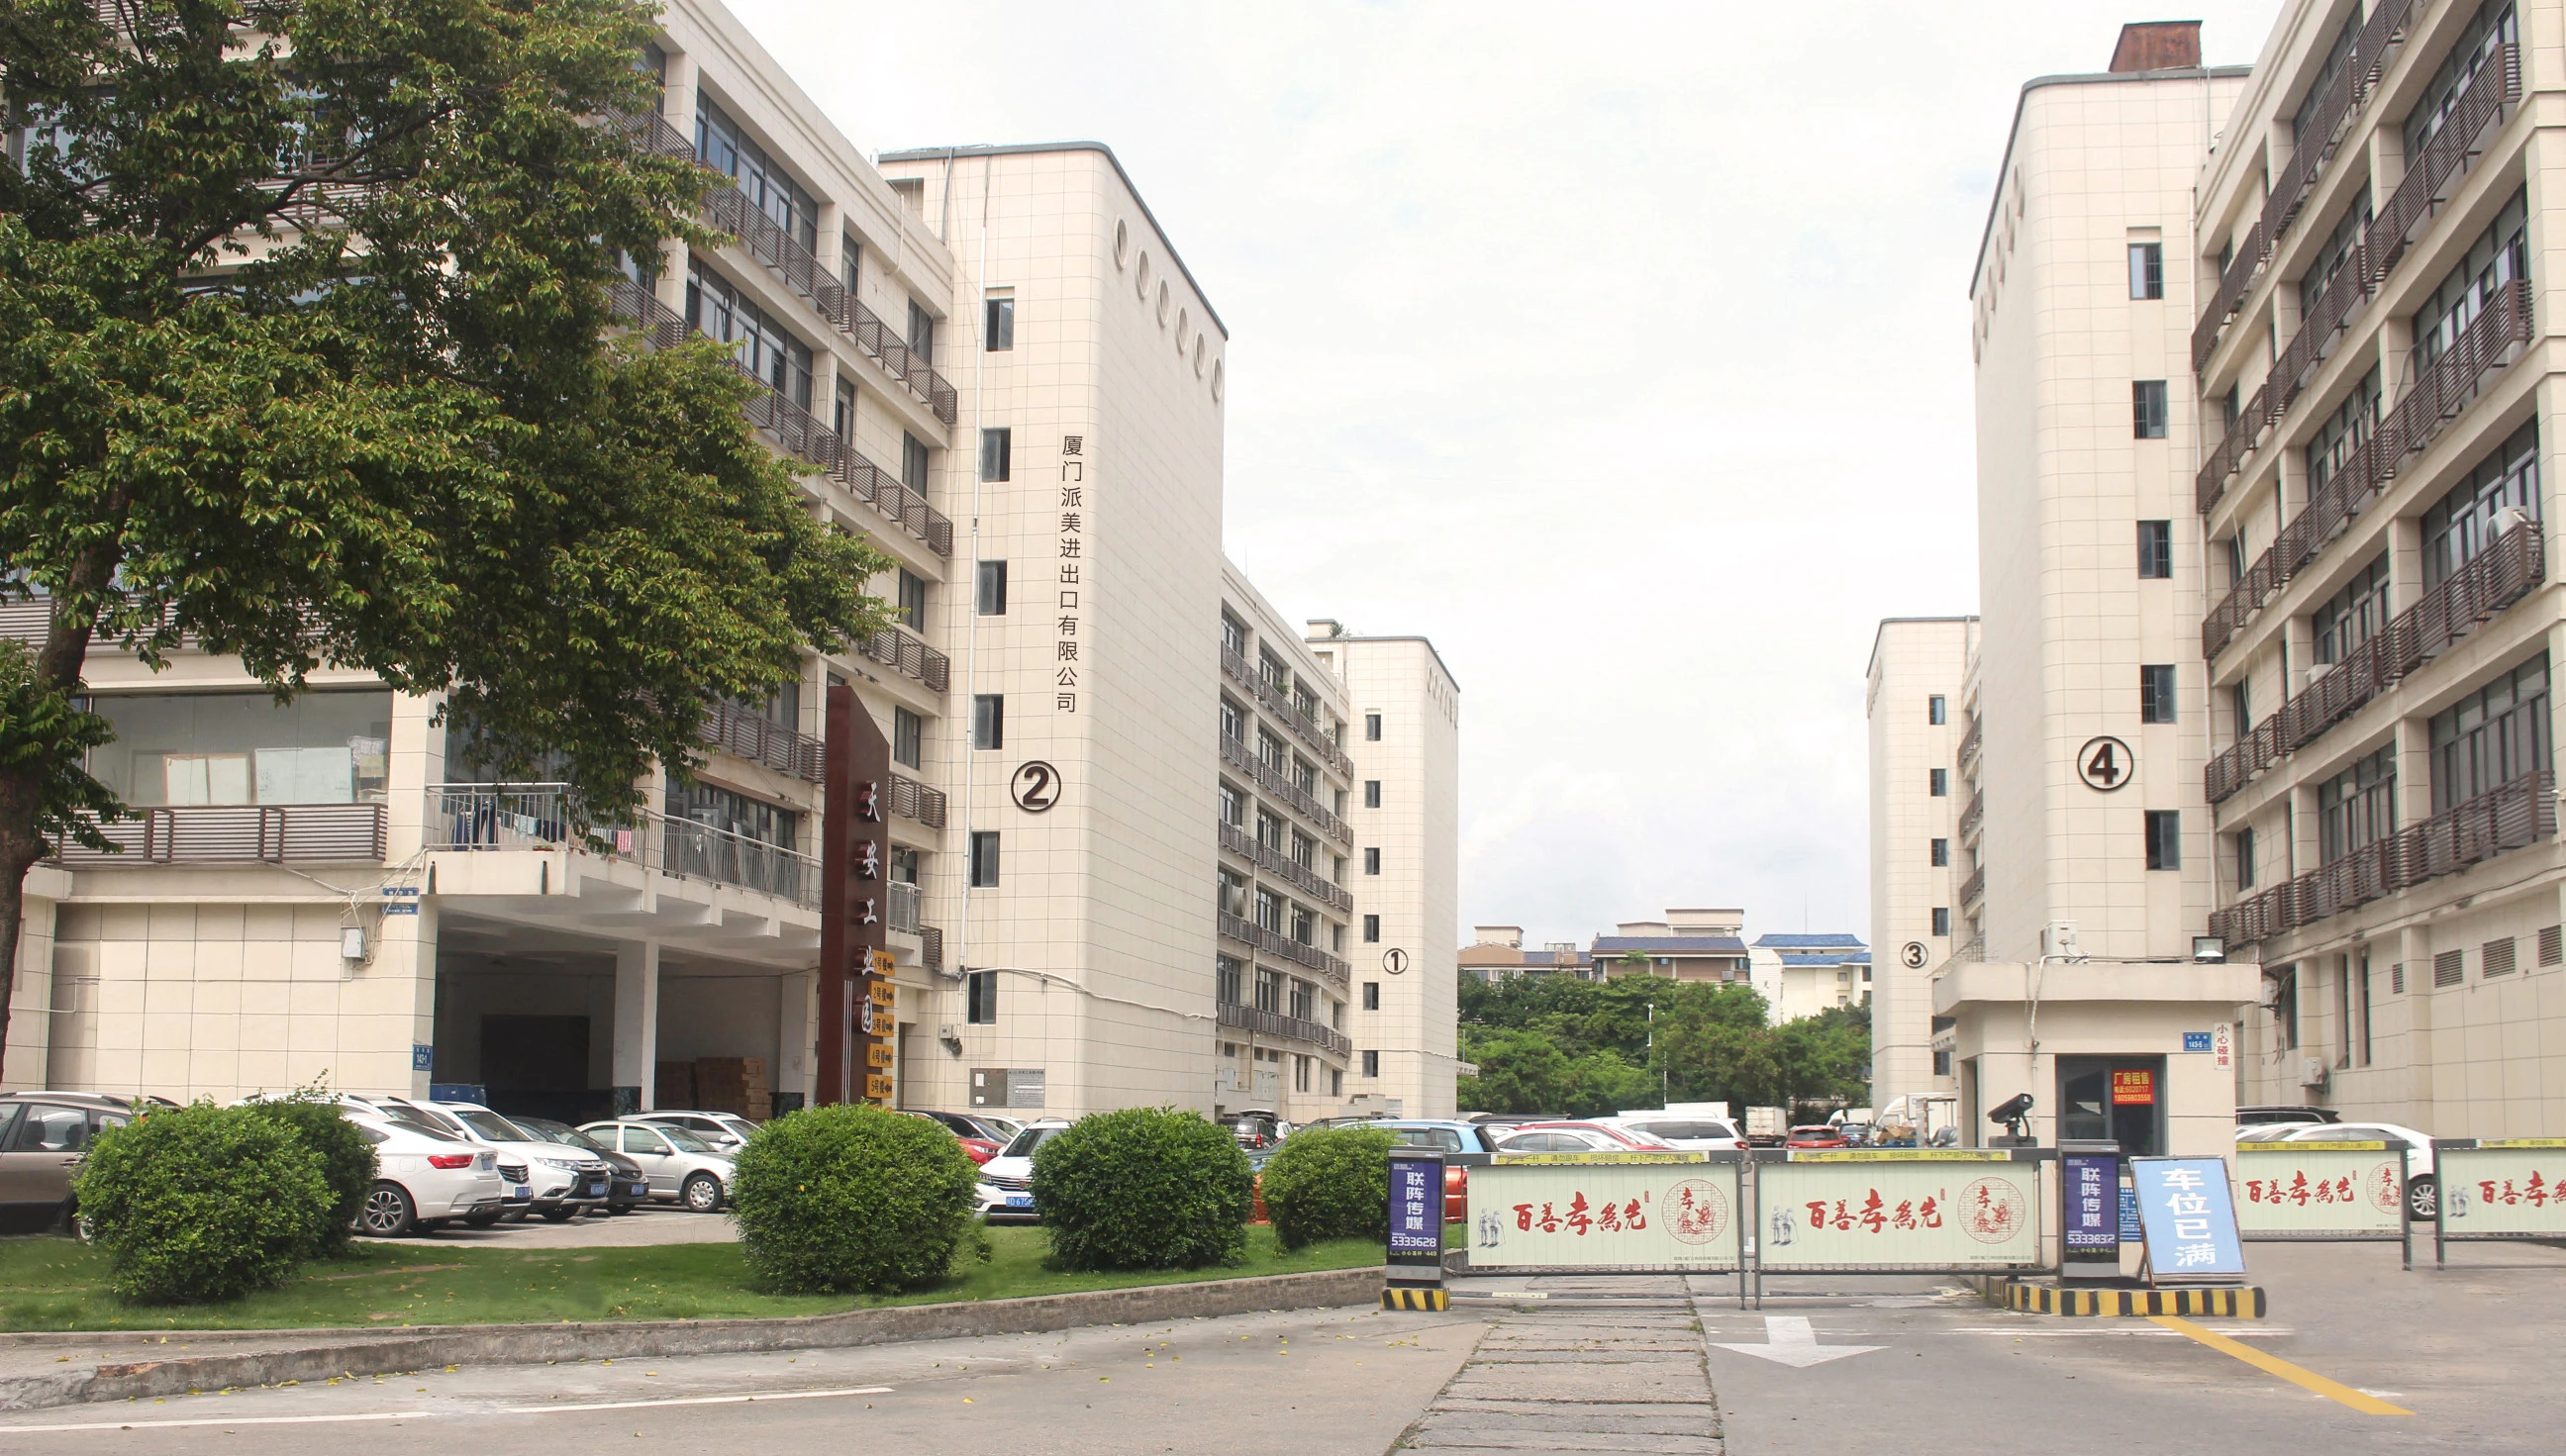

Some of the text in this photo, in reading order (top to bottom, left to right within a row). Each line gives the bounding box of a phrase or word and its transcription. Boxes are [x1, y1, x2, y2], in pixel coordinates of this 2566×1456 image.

[1056, 436, 1084, 713] 厦门派美进出口有限公司
[1023, 766, 1049, 805] 2
[2088, 742, 2119, 785] 4
[861, 781, 881, 1033] 天安工业园
[2217, 1023, 2228, 1066] 小心碰撞
[2114, 1072, 2149, 1085] 厂房租售
[1406, 1172, 1425, 1230] 联阵传媒
[2081, 1167, 2101, 1227] 联阵传媒
[2161, 1168, 2217, 1267] 车位已满
[1391, 1236, 1436, 1247] 5333628
